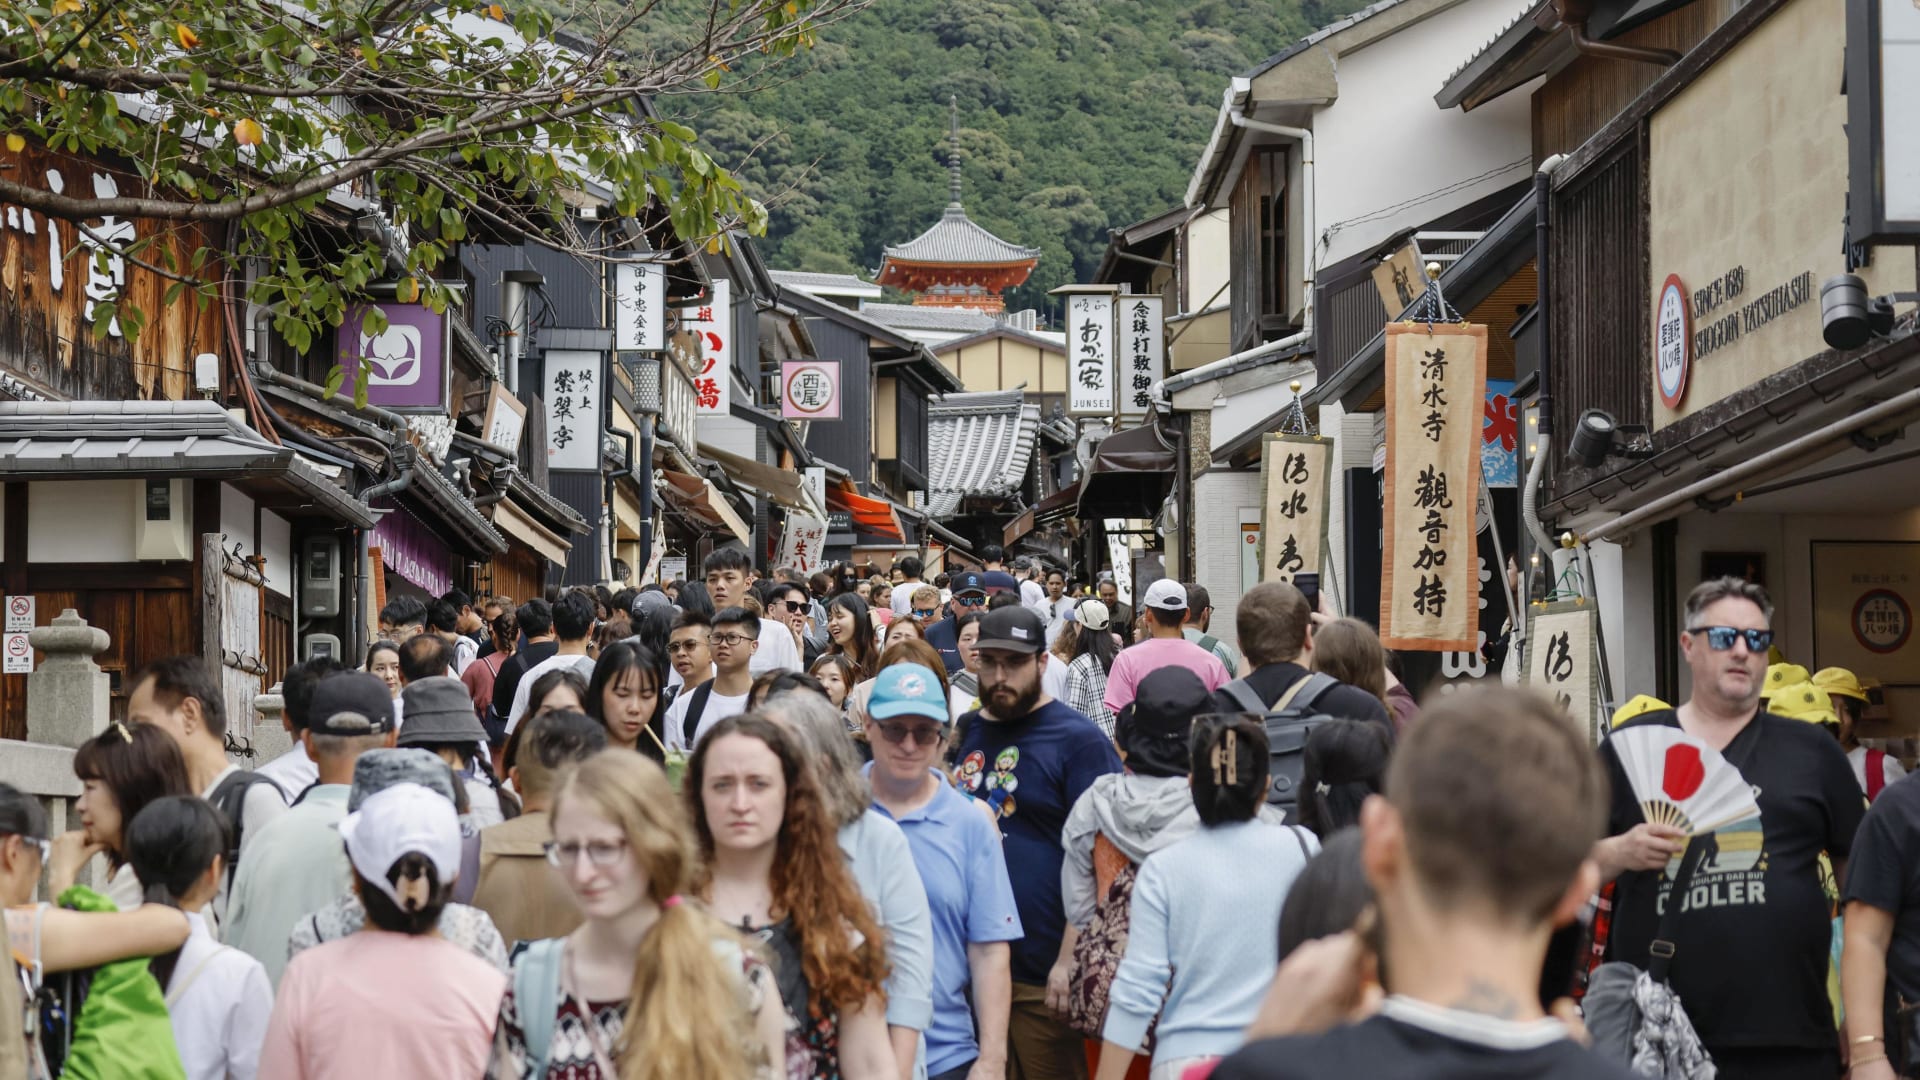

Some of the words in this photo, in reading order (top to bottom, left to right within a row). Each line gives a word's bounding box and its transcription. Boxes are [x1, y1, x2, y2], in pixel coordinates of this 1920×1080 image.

[633, 266, 647, 346] 田中忠金堂
[1694, 277, 1723, 320] SINCE
[1725, 265, 1744, 301] 1689
[1694, 311, 1739, 361] SHOGOIN
[1743, 270, 1811, 334] YATSUHASHI
[552, 368, 575, 450] 紫翠亭
[578, 368, 594, 410] 坂の上
[800, 373, 821, 406] 西尾
[1073, 399, 1110, 408] JUNSEI
[1421, 348, 1449, 442] 清水寺
[792, 540, 808, 577] 生八
[1726, 872, 1745, 882] DAD
[1747, 871, 1765, 881] BUT
